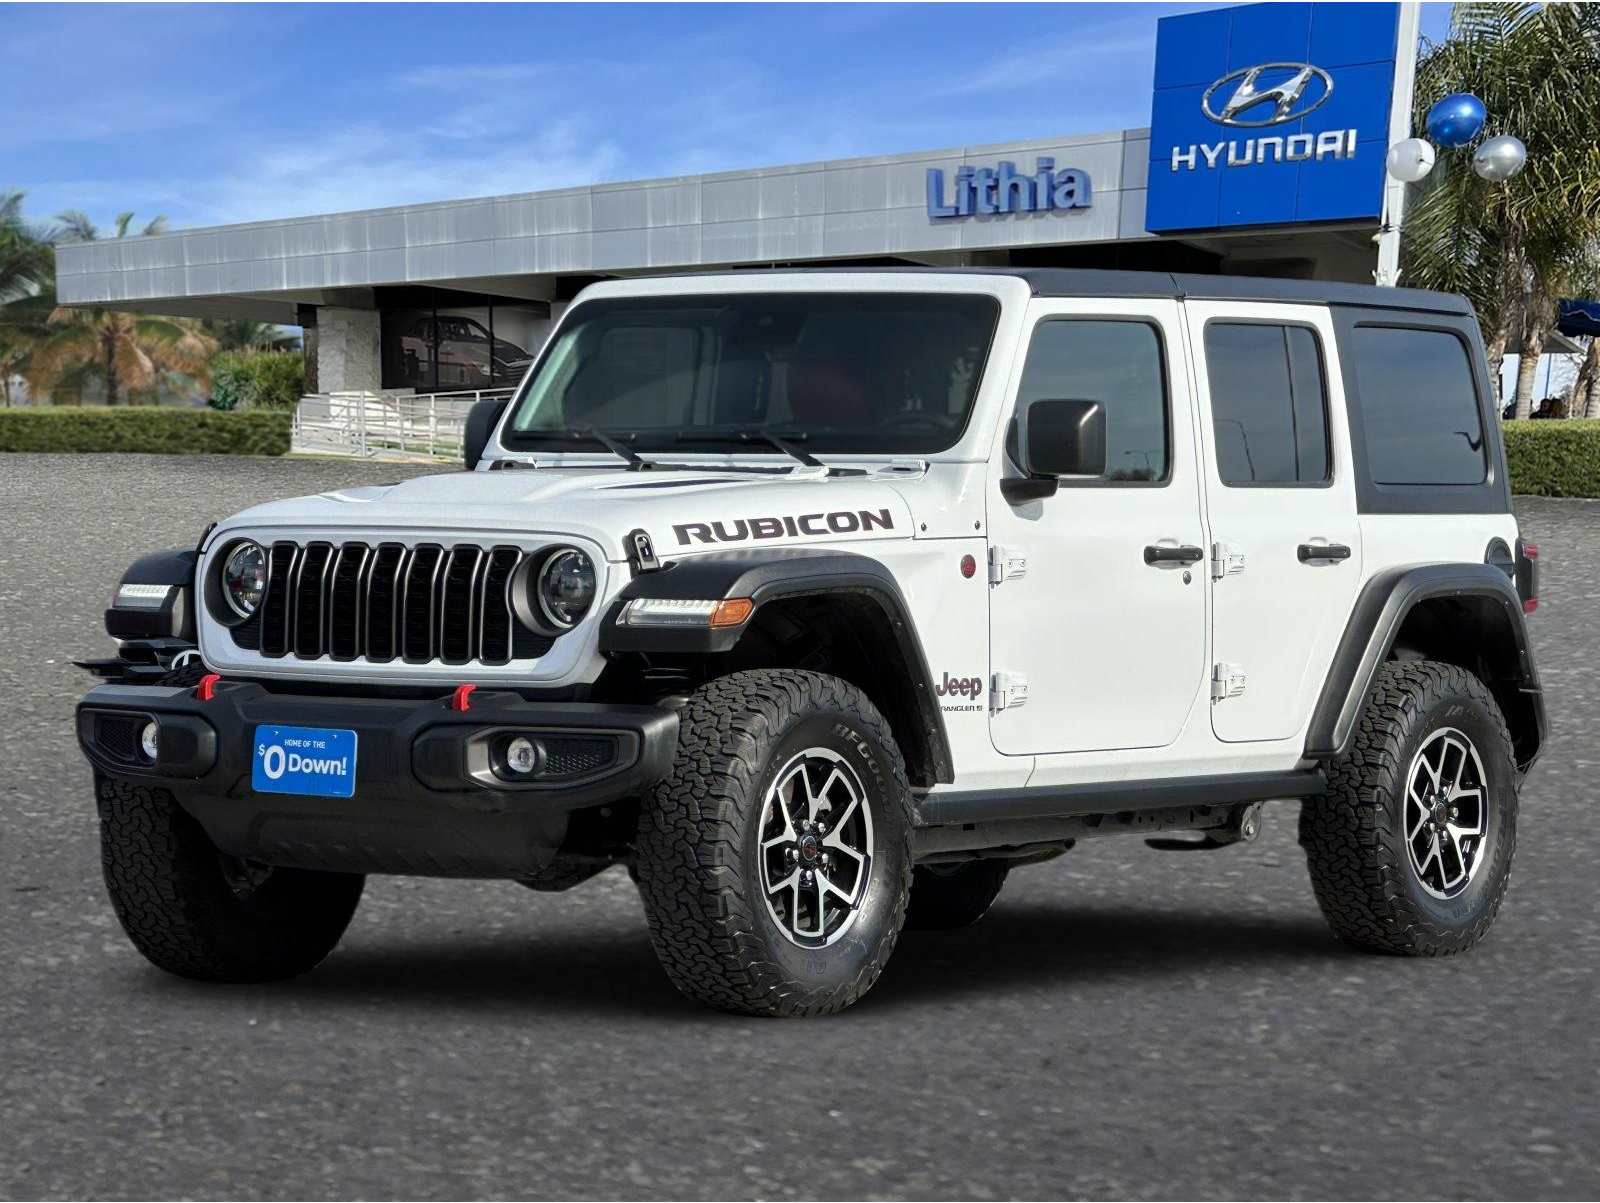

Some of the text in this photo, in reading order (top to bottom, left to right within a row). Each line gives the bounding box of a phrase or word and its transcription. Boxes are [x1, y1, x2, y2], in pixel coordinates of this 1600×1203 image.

[1171, 129, 1357, 171] HYUNDAI
[926, 156, 1093, 218] Lithia
[672, 508, 895, 546] RUBICON
[935, 671, 983, 701] Jeep
[284, 739, 326, 749] HOME OF THE
[288, 753, 347, 776] Down!
